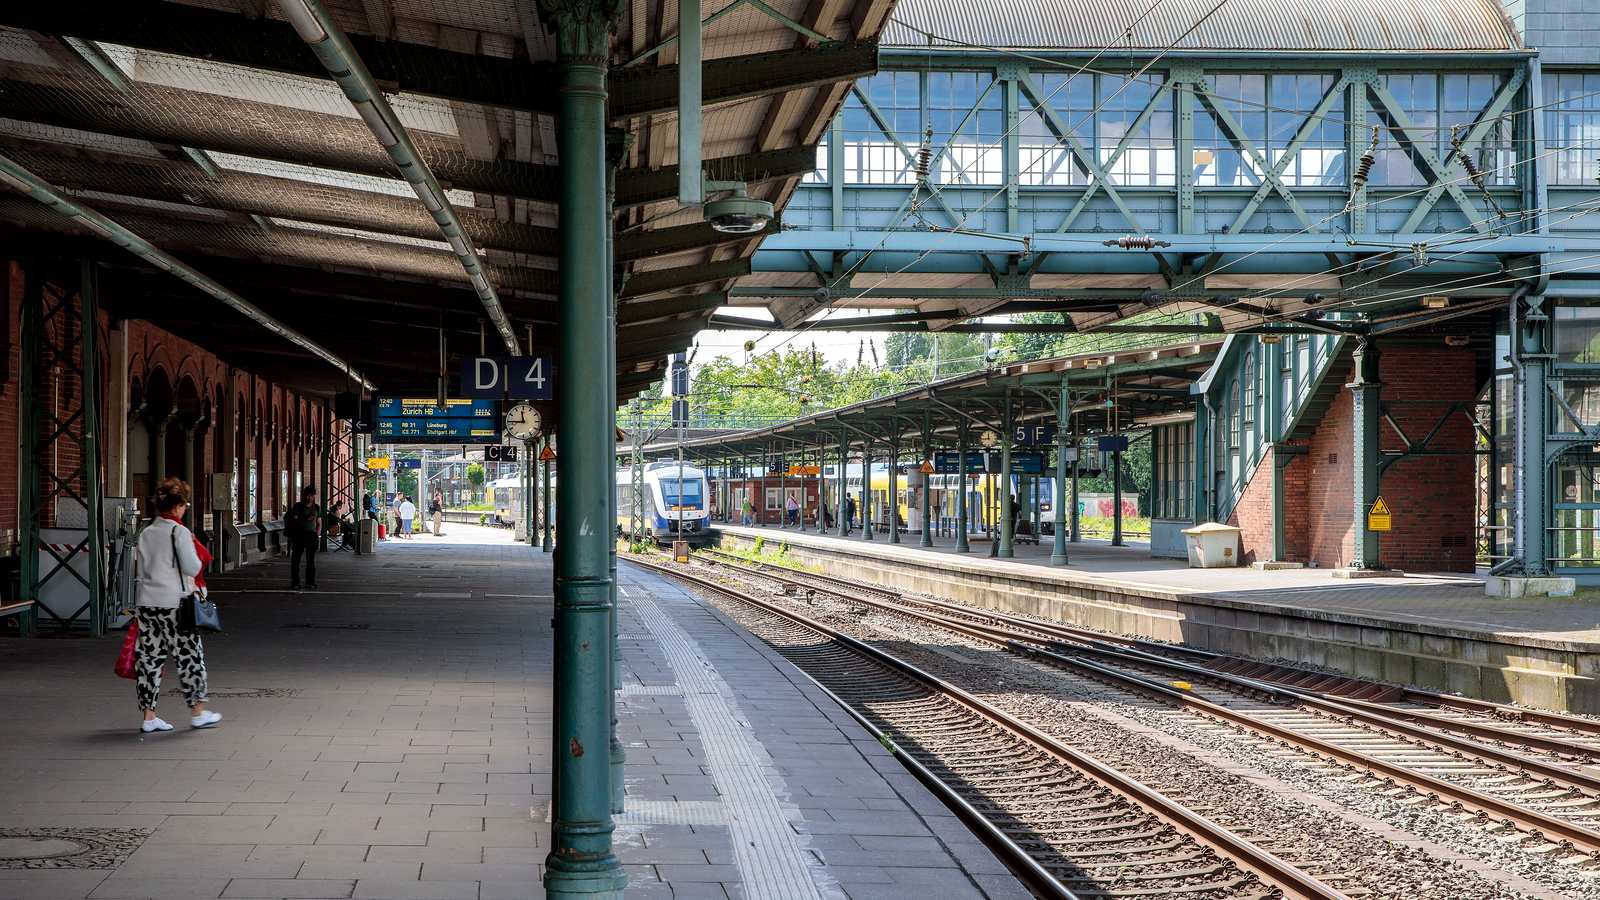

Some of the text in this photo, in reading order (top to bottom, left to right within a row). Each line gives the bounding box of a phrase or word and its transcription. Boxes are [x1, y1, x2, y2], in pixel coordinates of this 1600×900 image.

[475, 358, 546, 389] D 4
[1016, 426, 1044, 440] 5 F
[489, 446, 515, 458] C 4
